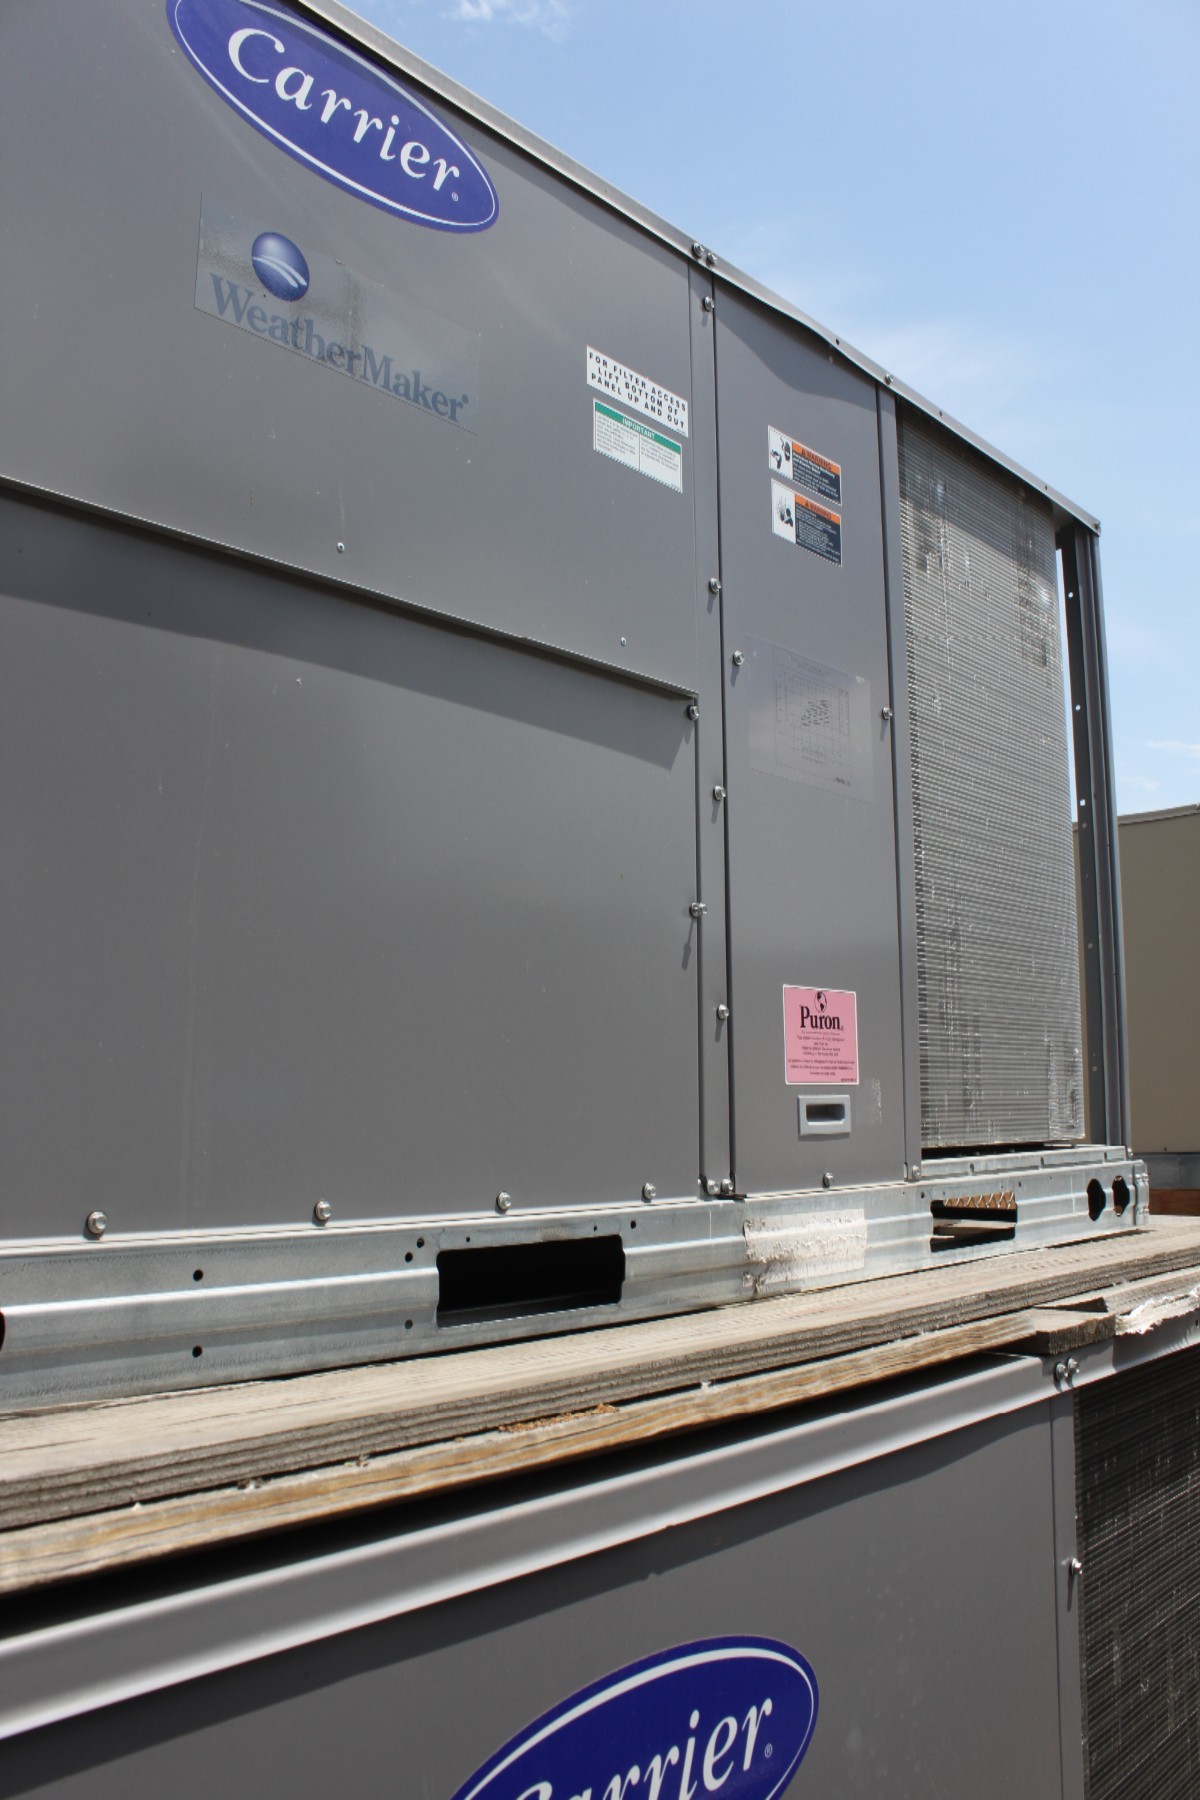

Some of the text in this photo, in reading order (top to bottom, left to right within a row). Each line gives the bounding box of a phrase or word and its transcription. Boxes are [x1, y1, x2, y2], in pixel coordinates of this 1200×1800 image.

[227, 27, 460, 193] Carrier
[209, 272, 464, 423] WeatherMaker
[589, 352, 686, 412] FOR FILTER ACCESS
[591, 373, 685, 429] PANEL UP AND OUT
[598, 367, 679, 416] LIFT BOTTOM OF
[622, 417, 656, 440] IMPORTANT
[799, 1004, 841, 1031] Puron
[516, 1697, 773, 1800] rrier
